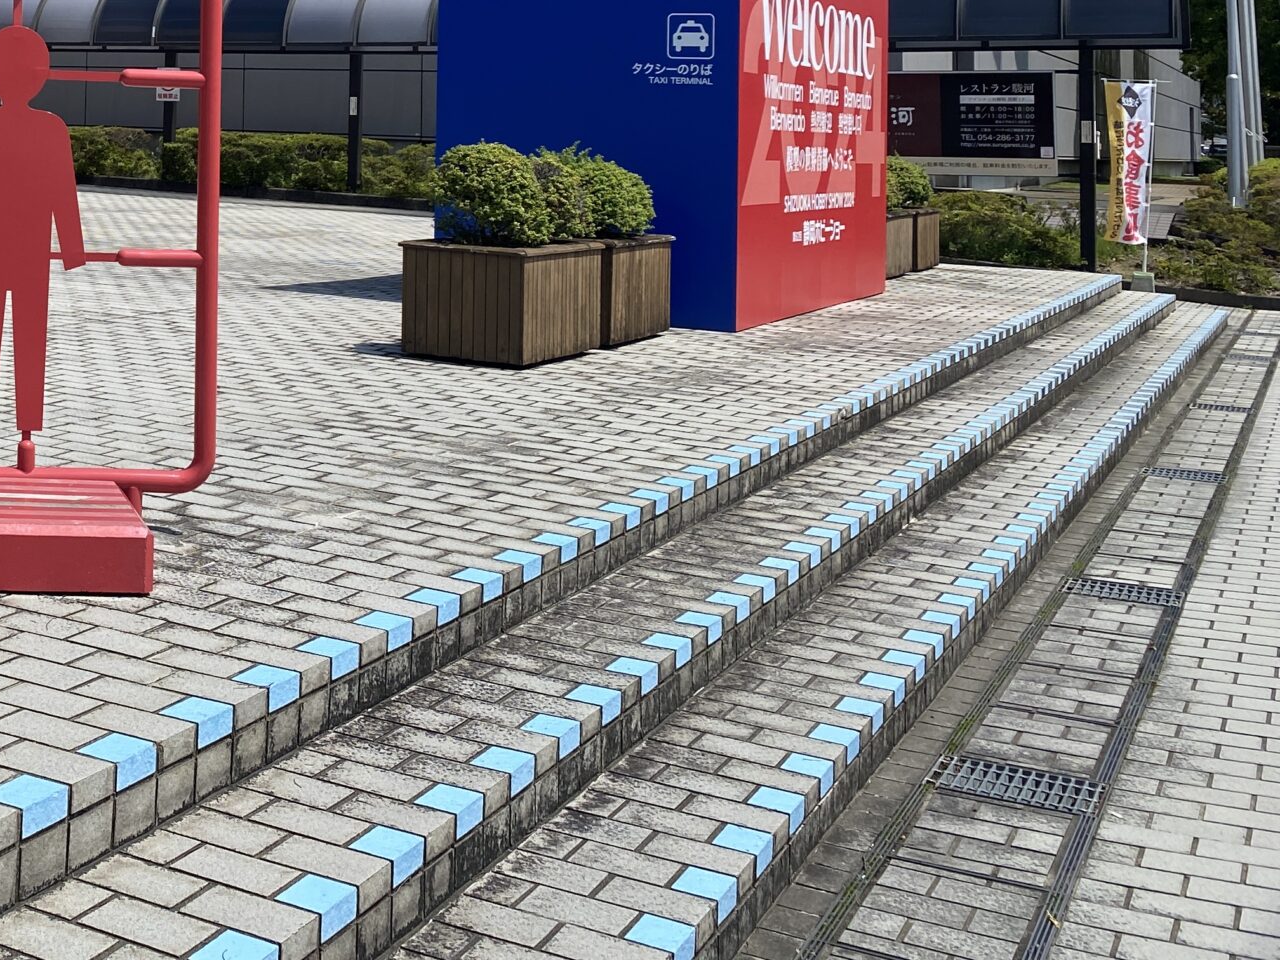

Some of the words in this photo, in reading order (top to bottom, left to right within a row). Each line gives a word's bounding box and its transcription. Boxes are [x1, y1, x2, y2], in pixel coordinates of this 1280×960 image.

[632, 62, 714, 76] タクシーのりば
[648, 76, 668, 84] TAXI
[670, 76, 714, 86] TERMINAL
[960, 83, 1035, 94] レストラン駿河
[763, 73, 804, 102] Willkommen
[809, 80, 840, 107] Bienvenue
[843, 85, 872, 111] Benvenuto
[770, 105, 806, 132] Bienvenido
[890, 106, 916, 126] 河
[977, 134, 1035, 142] 054-286-3177
[786, 145, 854, 172] 模型の世界首都へようこそ
[784, 194, 812, 214] SHIZUOKA
[803, 218, 846, 246] 静岡ホビーショー
